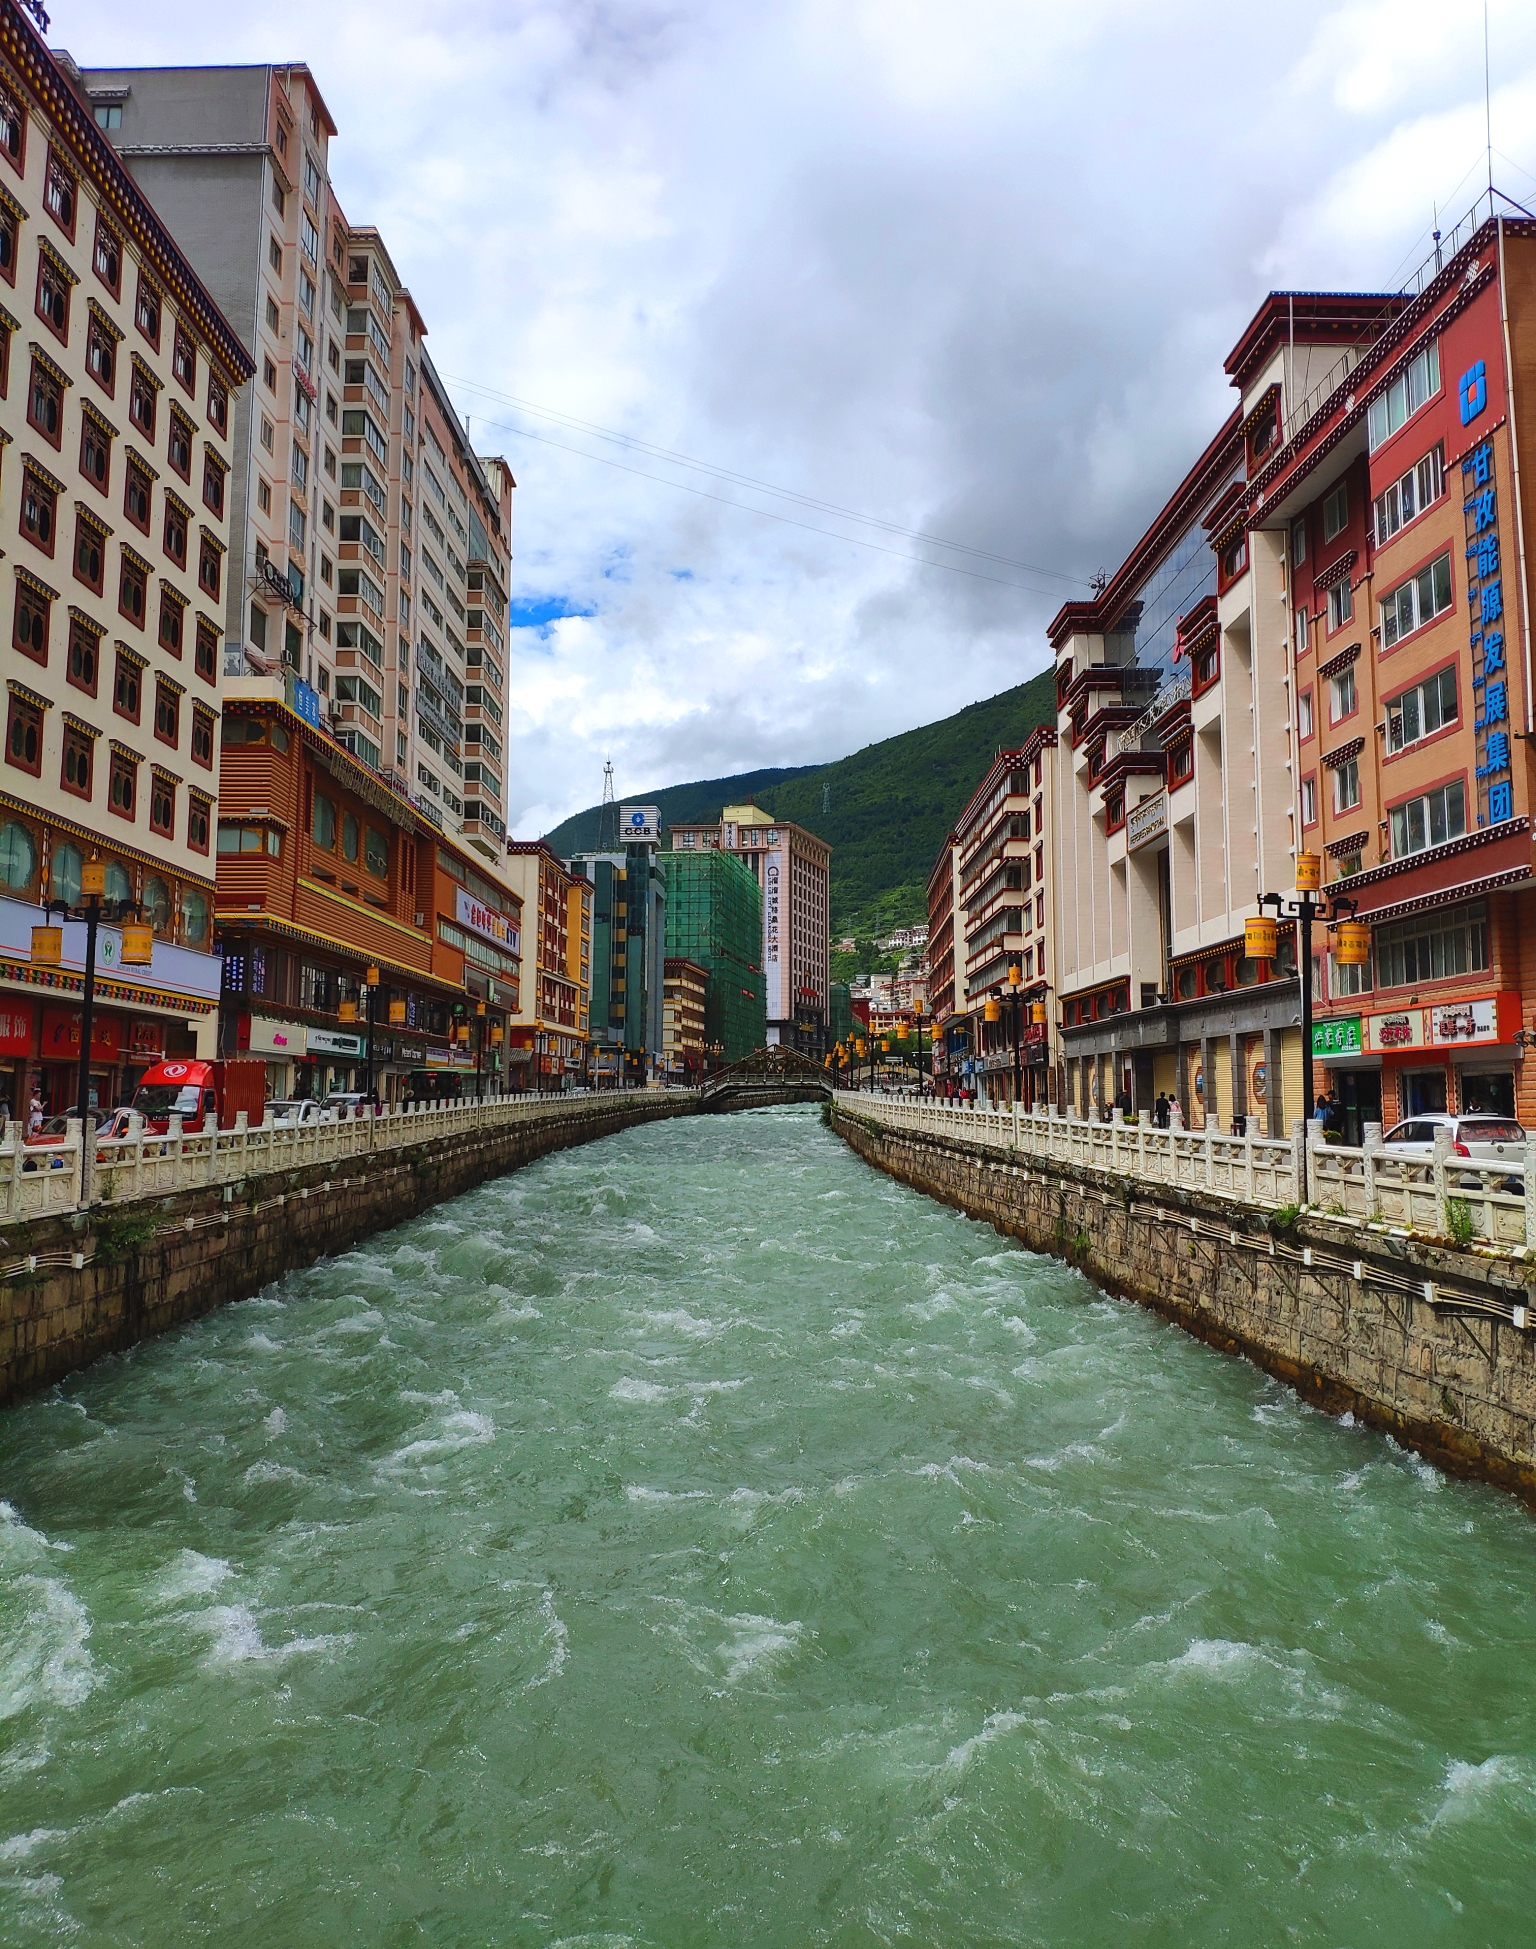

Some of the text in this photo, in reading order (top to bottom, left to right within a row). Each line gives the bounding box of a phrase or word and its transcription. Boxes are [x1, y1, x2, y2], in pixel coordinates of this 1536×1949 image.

[1472, 444, 1512, 825] 甘孜能源发展集团
